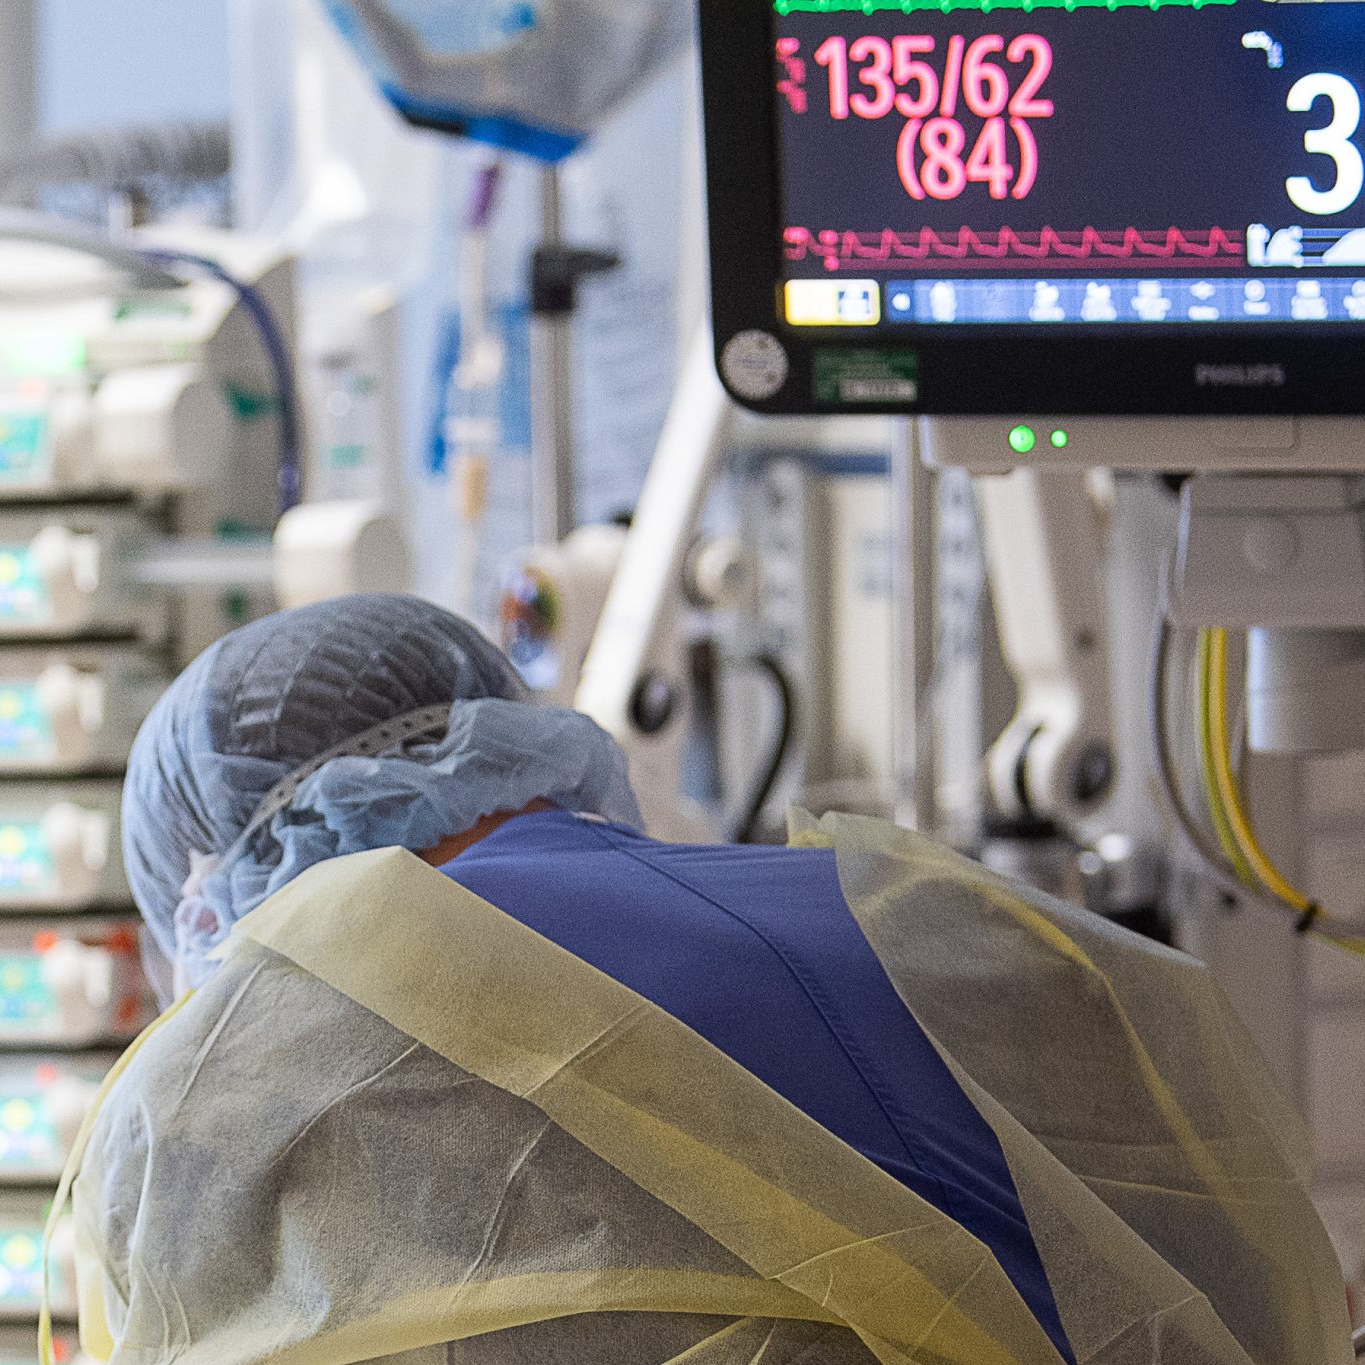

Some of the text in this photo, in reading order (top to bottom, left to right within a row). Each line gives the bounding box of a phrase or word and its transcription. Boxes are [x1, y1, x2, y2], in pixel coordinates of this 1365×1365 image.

[814, 33, 1054, 119] 135/62
[896, 116, 1038, 200] (84)
[1286, 72, 1364, 215] 3
